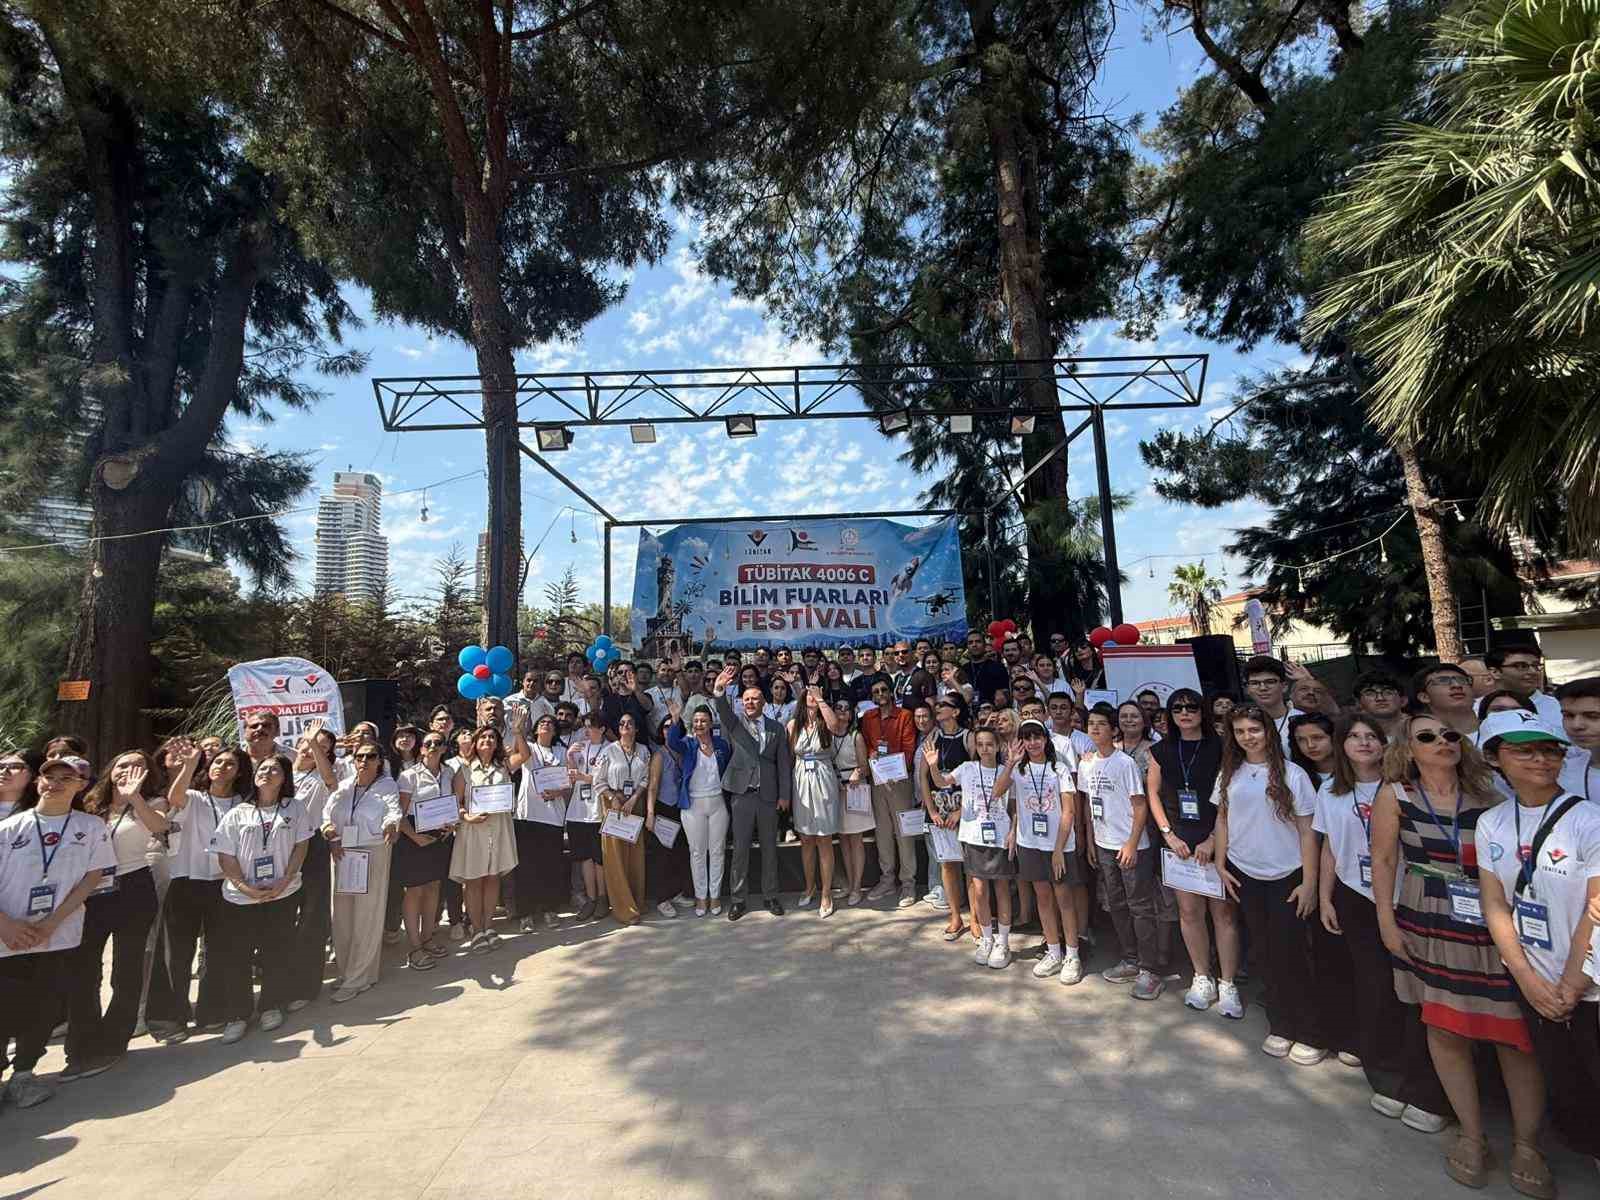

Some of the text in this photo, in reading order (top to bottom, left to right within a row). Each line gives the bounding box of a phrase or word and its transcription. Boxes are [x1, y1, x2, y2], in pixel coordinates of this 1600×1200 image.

[744, 564, 870, 582] TÜBİTAK 4006 C
[719, 585, 889, 606] BİLİM FUARLARI
[735, 604, 877, 631] FESTİVALİ
